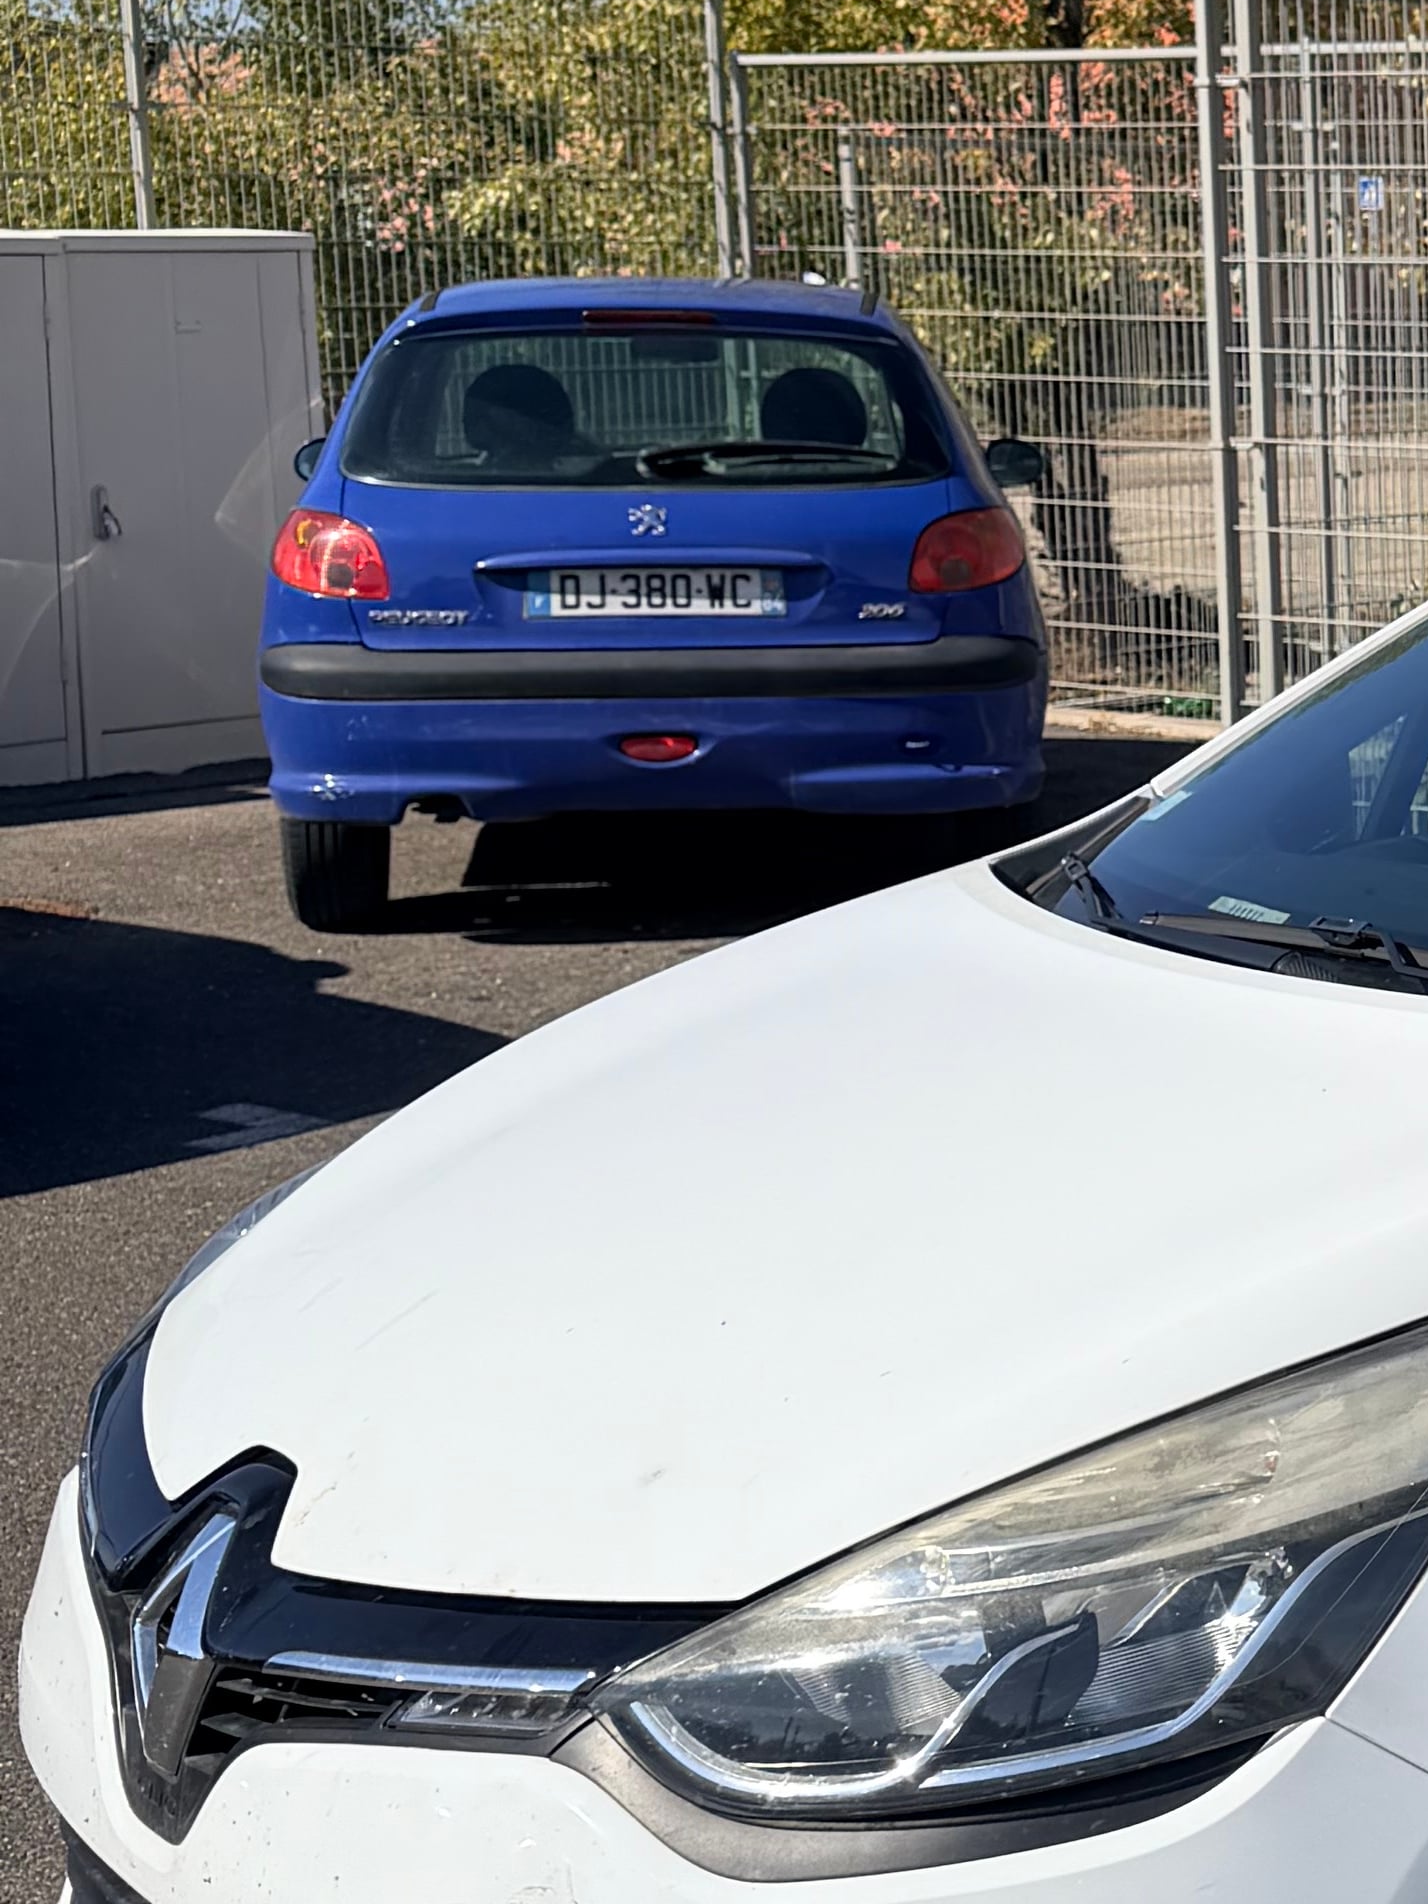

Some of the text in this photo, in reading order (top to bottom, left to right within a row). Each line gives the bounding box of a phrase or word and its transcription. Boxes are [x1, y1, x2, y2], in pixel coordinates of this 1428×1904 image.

[558, 573, 752, 610] DJ-380-WC
[367, 608, 470, 626] PEUGEOT
[857, 601, 907, 620] 206
